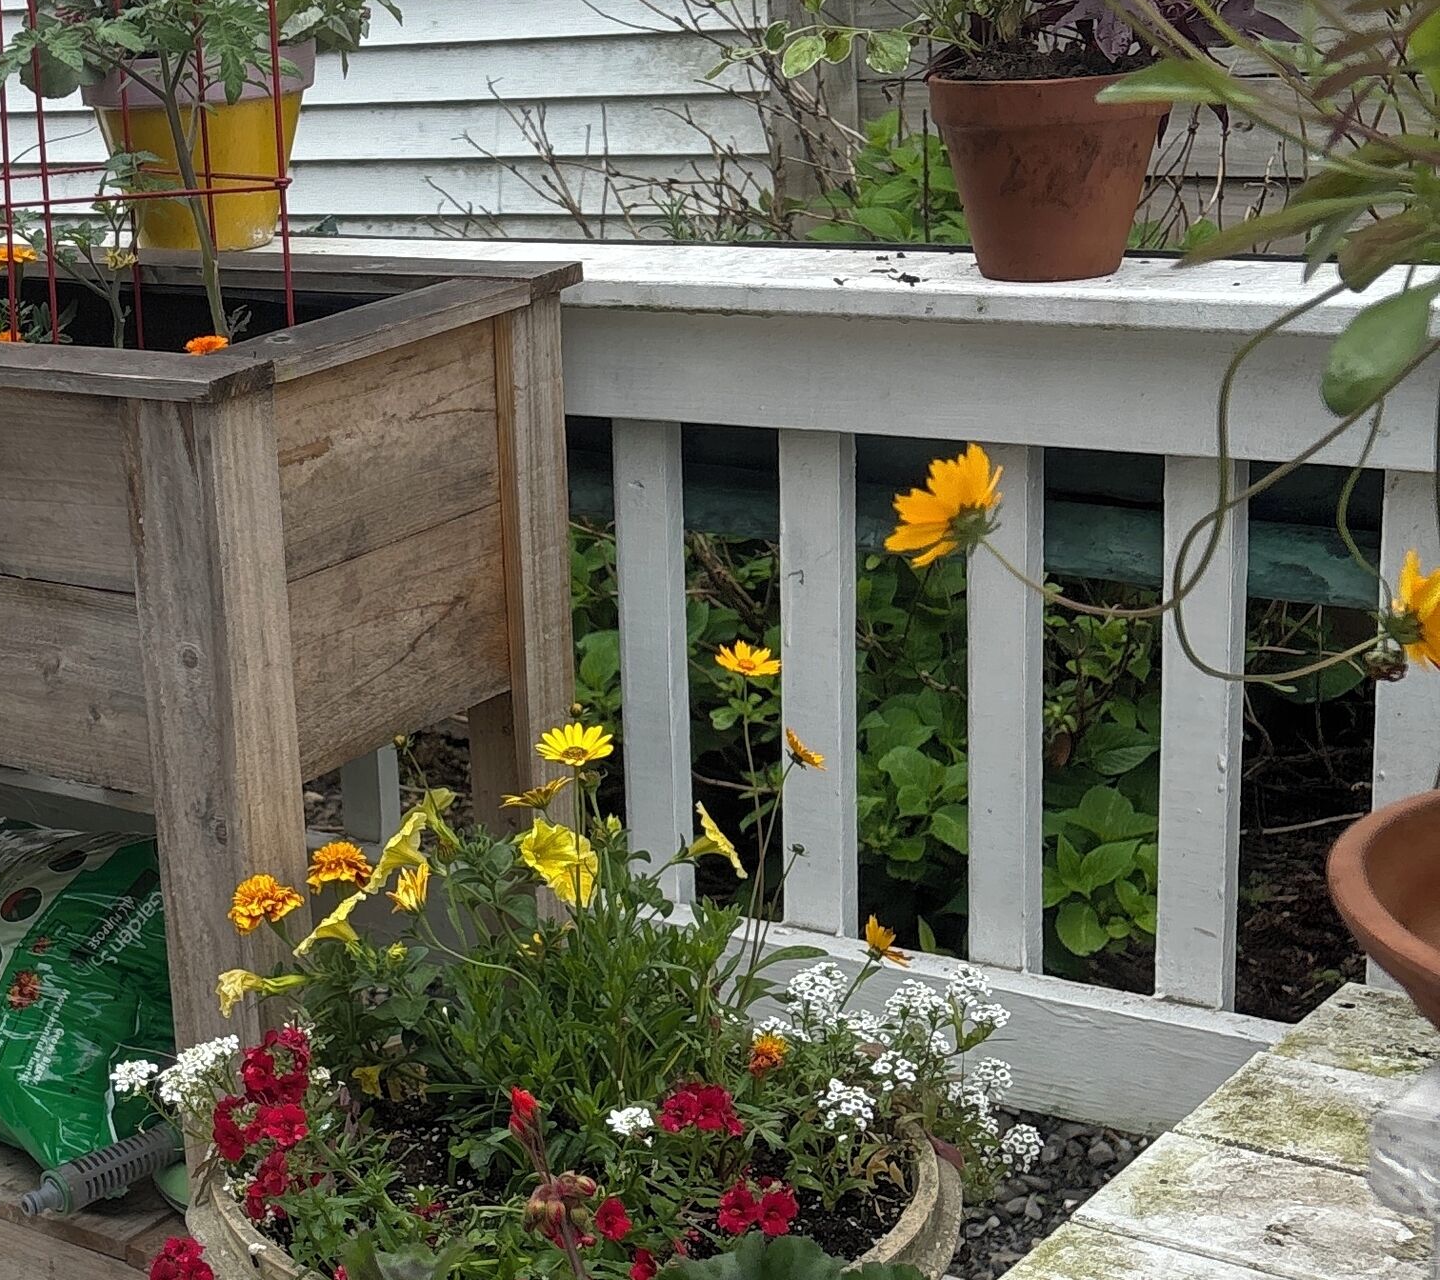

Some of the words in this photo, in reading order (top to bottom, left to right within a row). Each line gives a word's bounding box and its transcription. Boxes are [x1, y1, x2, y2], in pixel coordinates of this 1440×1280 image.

[86, 912, 123, 951] PURPOSE
[107, 892, 162, 955] Garden
[52, 987, 71, 1012] More
